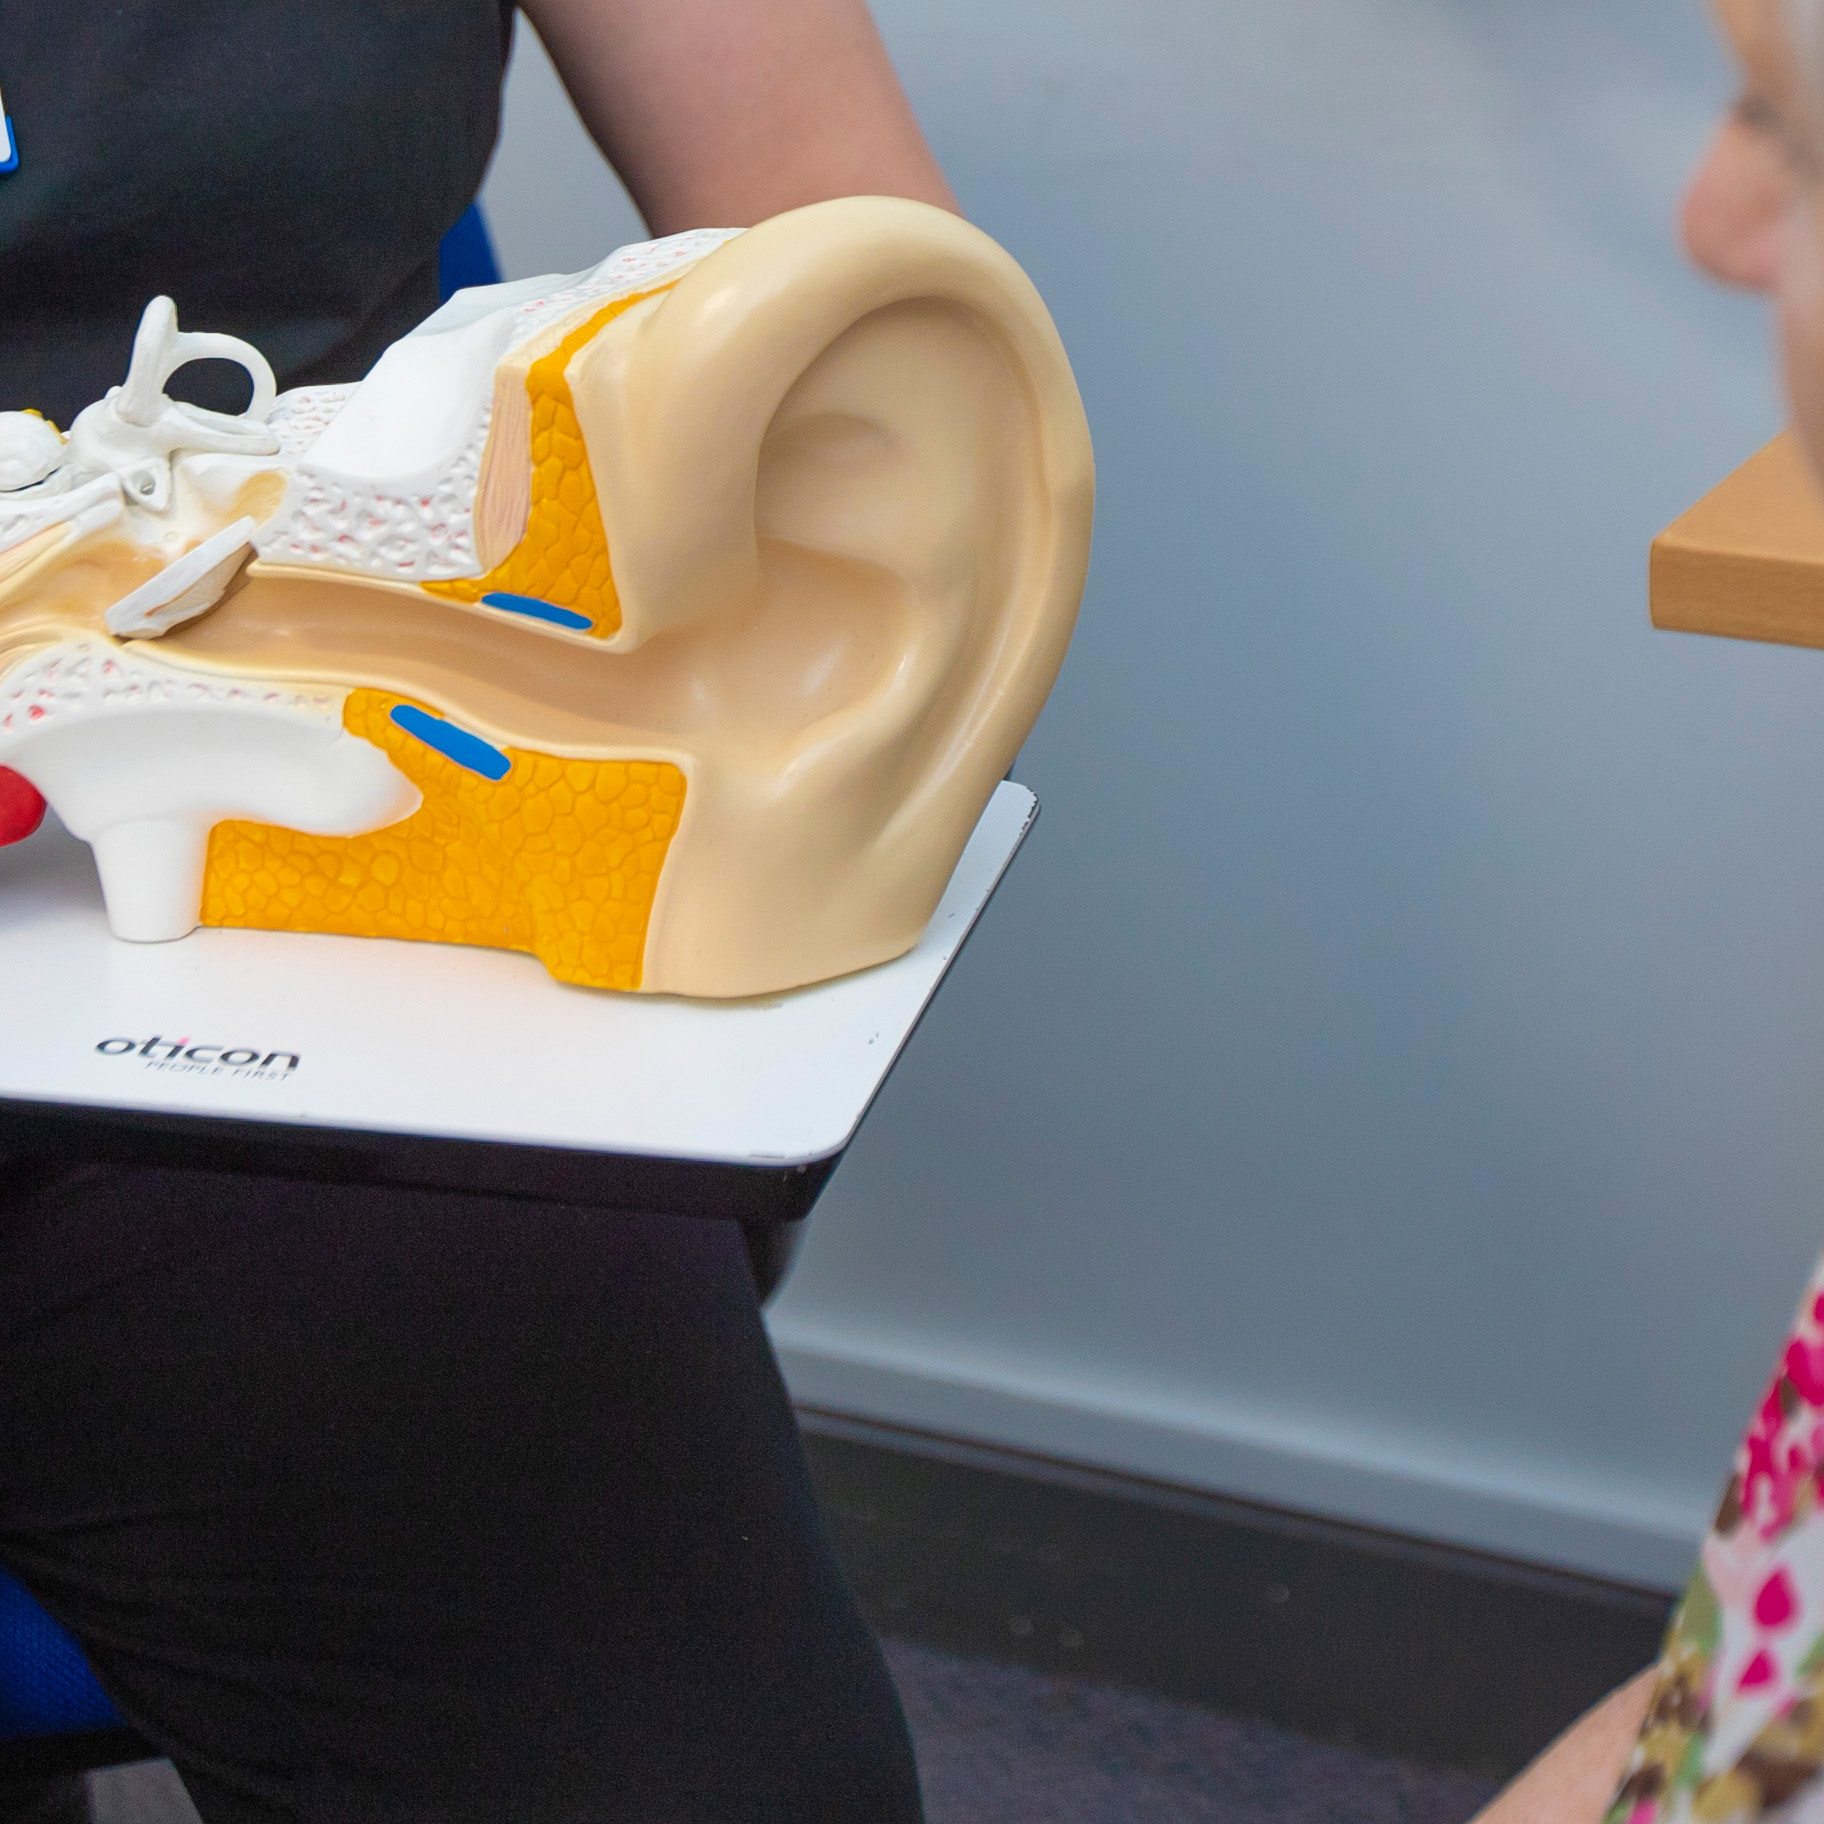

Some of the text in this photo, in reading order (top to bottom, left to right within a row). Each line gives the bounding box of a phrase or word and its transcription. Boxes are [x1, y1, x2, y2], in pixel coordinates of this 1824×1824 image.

[94, 1035, 301, 1072] oticon
[144, 1061, 295, 1081] PEOPLE FIRST
